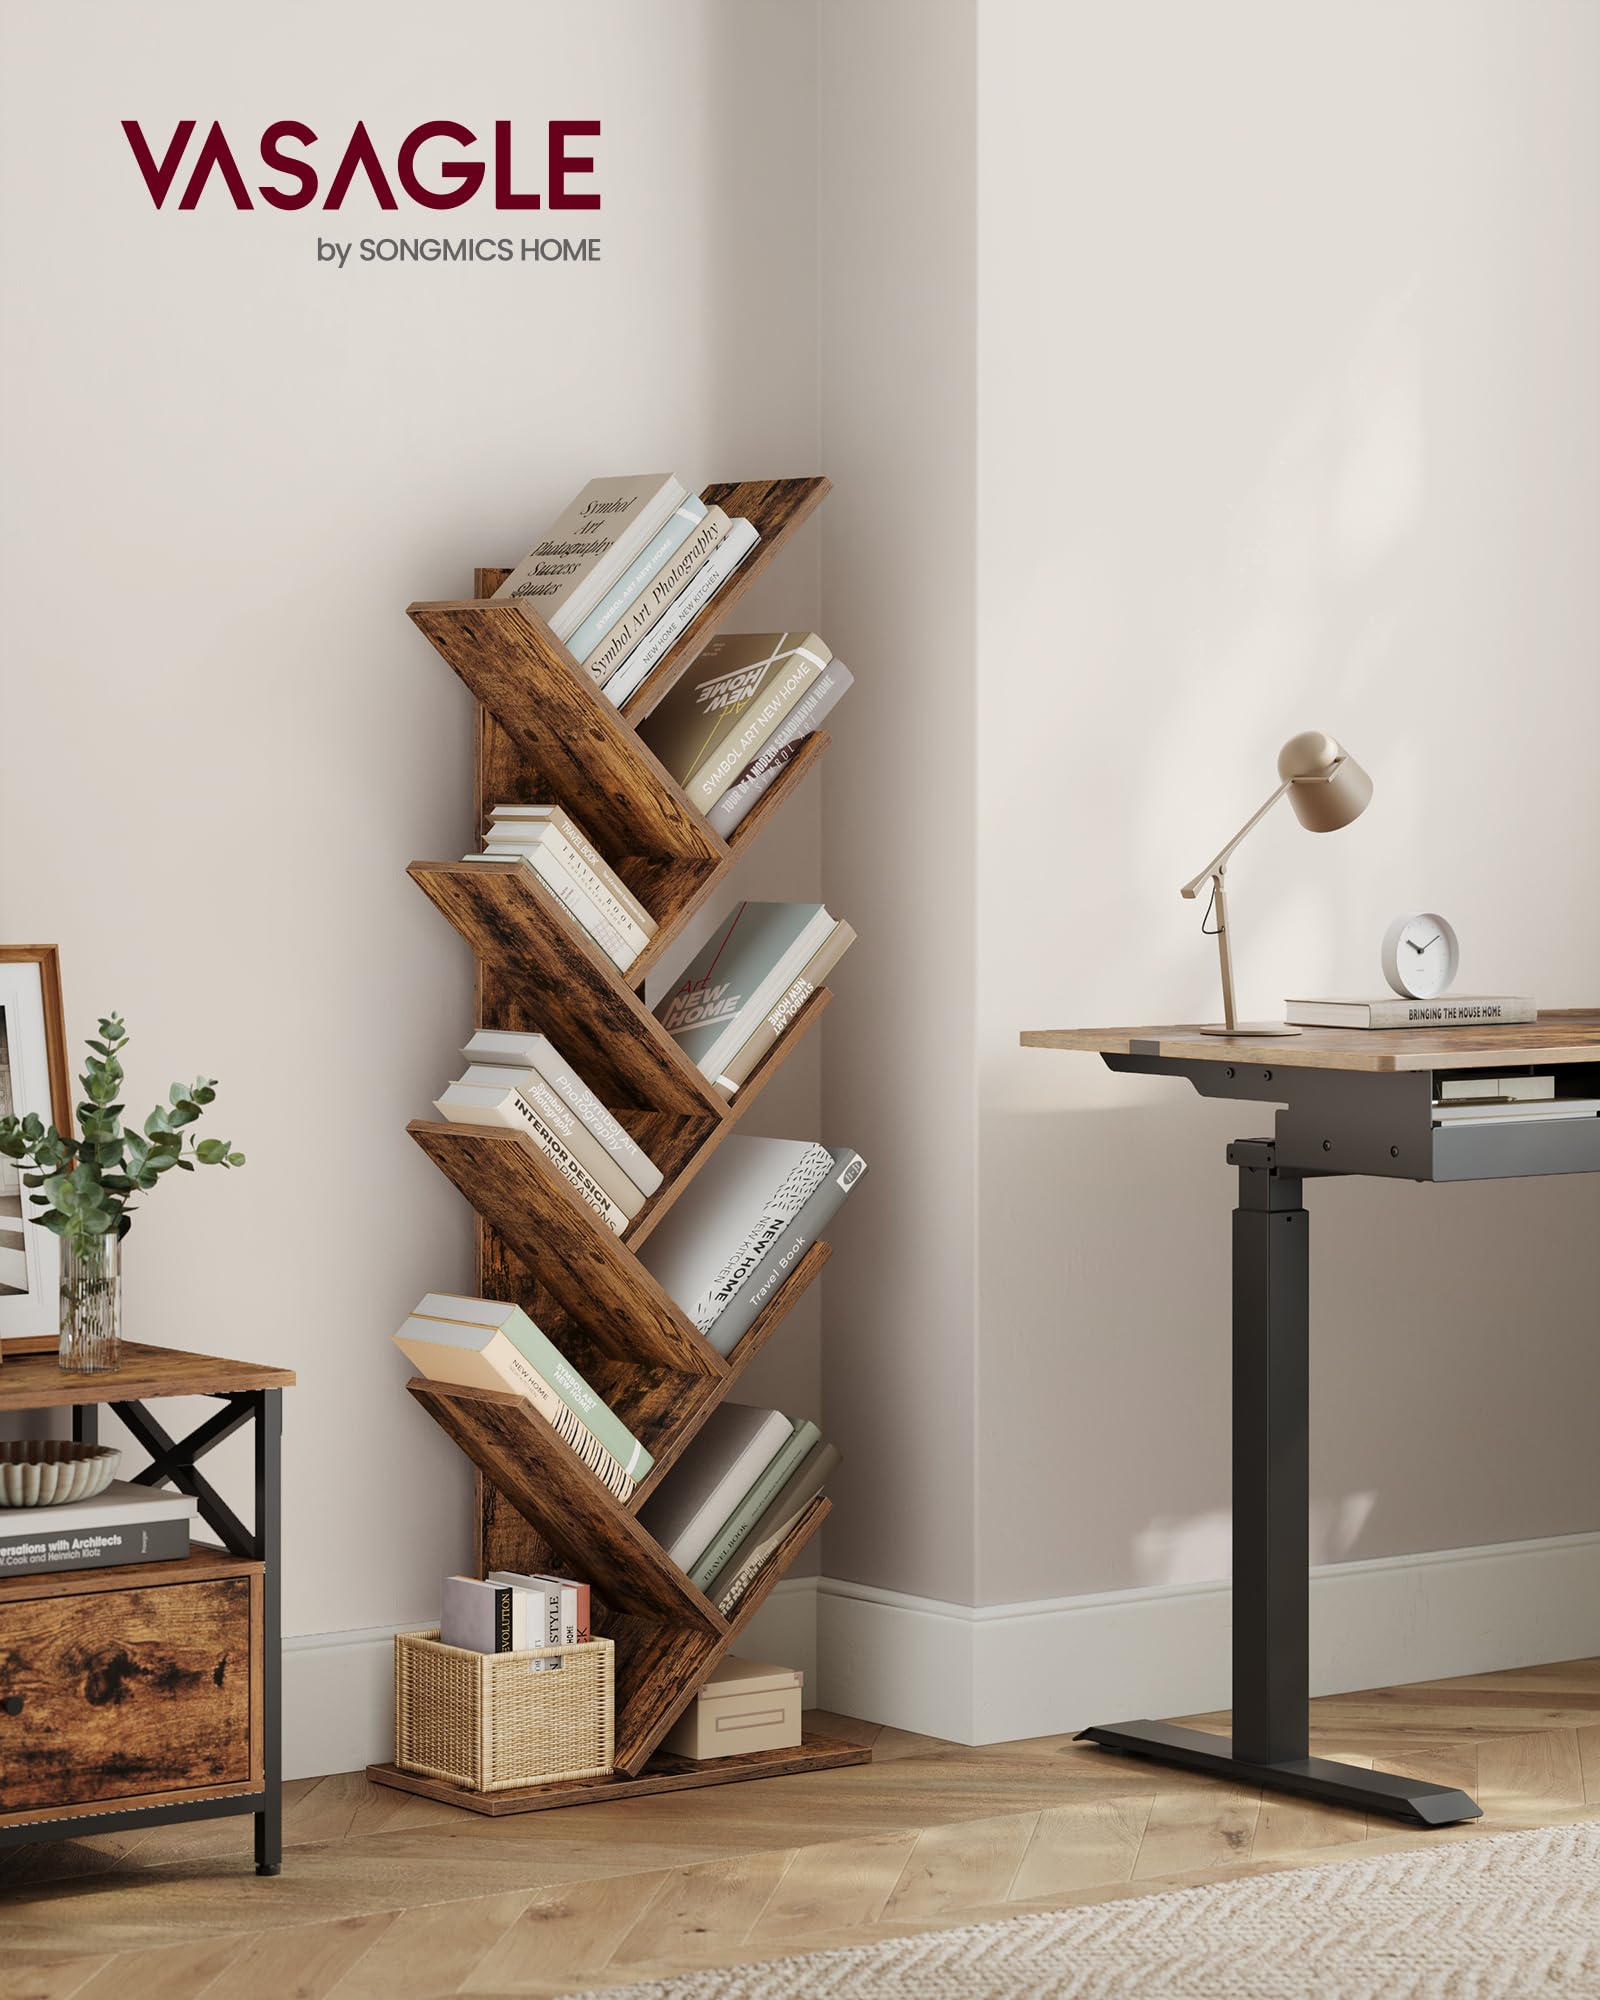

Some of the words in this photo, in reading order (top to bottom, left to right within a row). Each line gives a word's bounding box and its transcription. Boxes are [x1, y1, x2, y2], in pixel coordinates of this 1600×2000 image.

[579, 496, 638, 518] Symbol
[573, 520, 605, 535] Art
[529, 537, 615, 559] Photography
[527, 561, 581, 577] Success
[622, 581, 637, 600] ART
[636, 561, 653, 583] NEW
[652, 538, 673, 565] HOME
[510, 581, 563, 598] Quotes
[590, 623, 632, 680] Symbol
[633, 603, 652, 633] Art
[652, 522, 720, 605] Photography
[642, 643, 659, 665] NEW
[657, 621, 679, 647] HOME
[678, 603, 694, 621] NEW
[694, 572, 720, 604] KITCHEN
[696, 668, 762, 703] HOME
[703, 685, 755, 714] NEW
[702, 748, 743, 796] SYMBOL
[740, 725, 760, 751] ART
[758, 695, 783, 728] NEW
[780, 662, 811, 699] HOME
[720, 789, 742, 814] TOUR
[738, 780, 750, 794] OF
[750, 744, 780, 777] MODERN
[775, 699, 818, 746] SCANDINAVIAN
[815, 675, 836, 699] HOME
[561, 820, 583, 849] TRAVEL
[580, 844, 600, 866] BOOK
[606, 897, 632, 931] BOOK
[671, 983, 732, 1011] NEW
[678, 976, 712, 994] Art
[785, 982, 814, 1017] SYMBOL
[788, 977, 807, 1001] NEW
[668, 995, 743, 1029] HOME
[768, 997, 791, 1026] HOME
[773, 1015, 788, 1037] ART
[1408, 1008, 1442, 1021] BRINGING
[1443, 1007, 1457, 1019] THE
[1458, 1006, 1481, 1018] HOUSE
[1482, 1005, 1501, 1018] HOME
[528, 1086, 574, 1138] Photography
[536, 1082, 566, 1114] Symbol
[562, 1111, 577, 1127] Art
[555, 1075, 624, 1152] Photography
[581, 1090, 621, 1137] Symbol
[620, 1137, 639, 1157] Art
[514, 1098, 569, 1163] INTERIOR
[567, 1158, 612, 1211] DESIGN
[748, 1215, 771, 1240] NEW
[753, 1218, 785, 1254] NEW
[714, 1240, 752, 1284] KITCHEN
[714, 1257, 756, 1302] HOME
[749, 1268, 780, 1306] Travel
[778, 1236, 806, 1269] Book
[512, 1359, 529, 1378] NEW
[528, 1377, 550, 1401] HOME
[553, 1371, 571, 1390] NEW
[570, 1388, 593, 1413] HOME
[556, 1363, 583, 1393] SYMBOL
[582, 1393, 598, 1409] ART
[30, 1552, 47, 1564] and
[48, 1549, 81, 1563] Heinrich
[48, 1536, 70, 1553] with
[72, 1534, 122, 1550] Architects
[703, 1549, 729, 1581] TRAVEL
[728, 1523, 748, 1548] BOOK
[549, 1596, 559, 1643] STYLE
[566, 1625, 574, 1644] HOME
